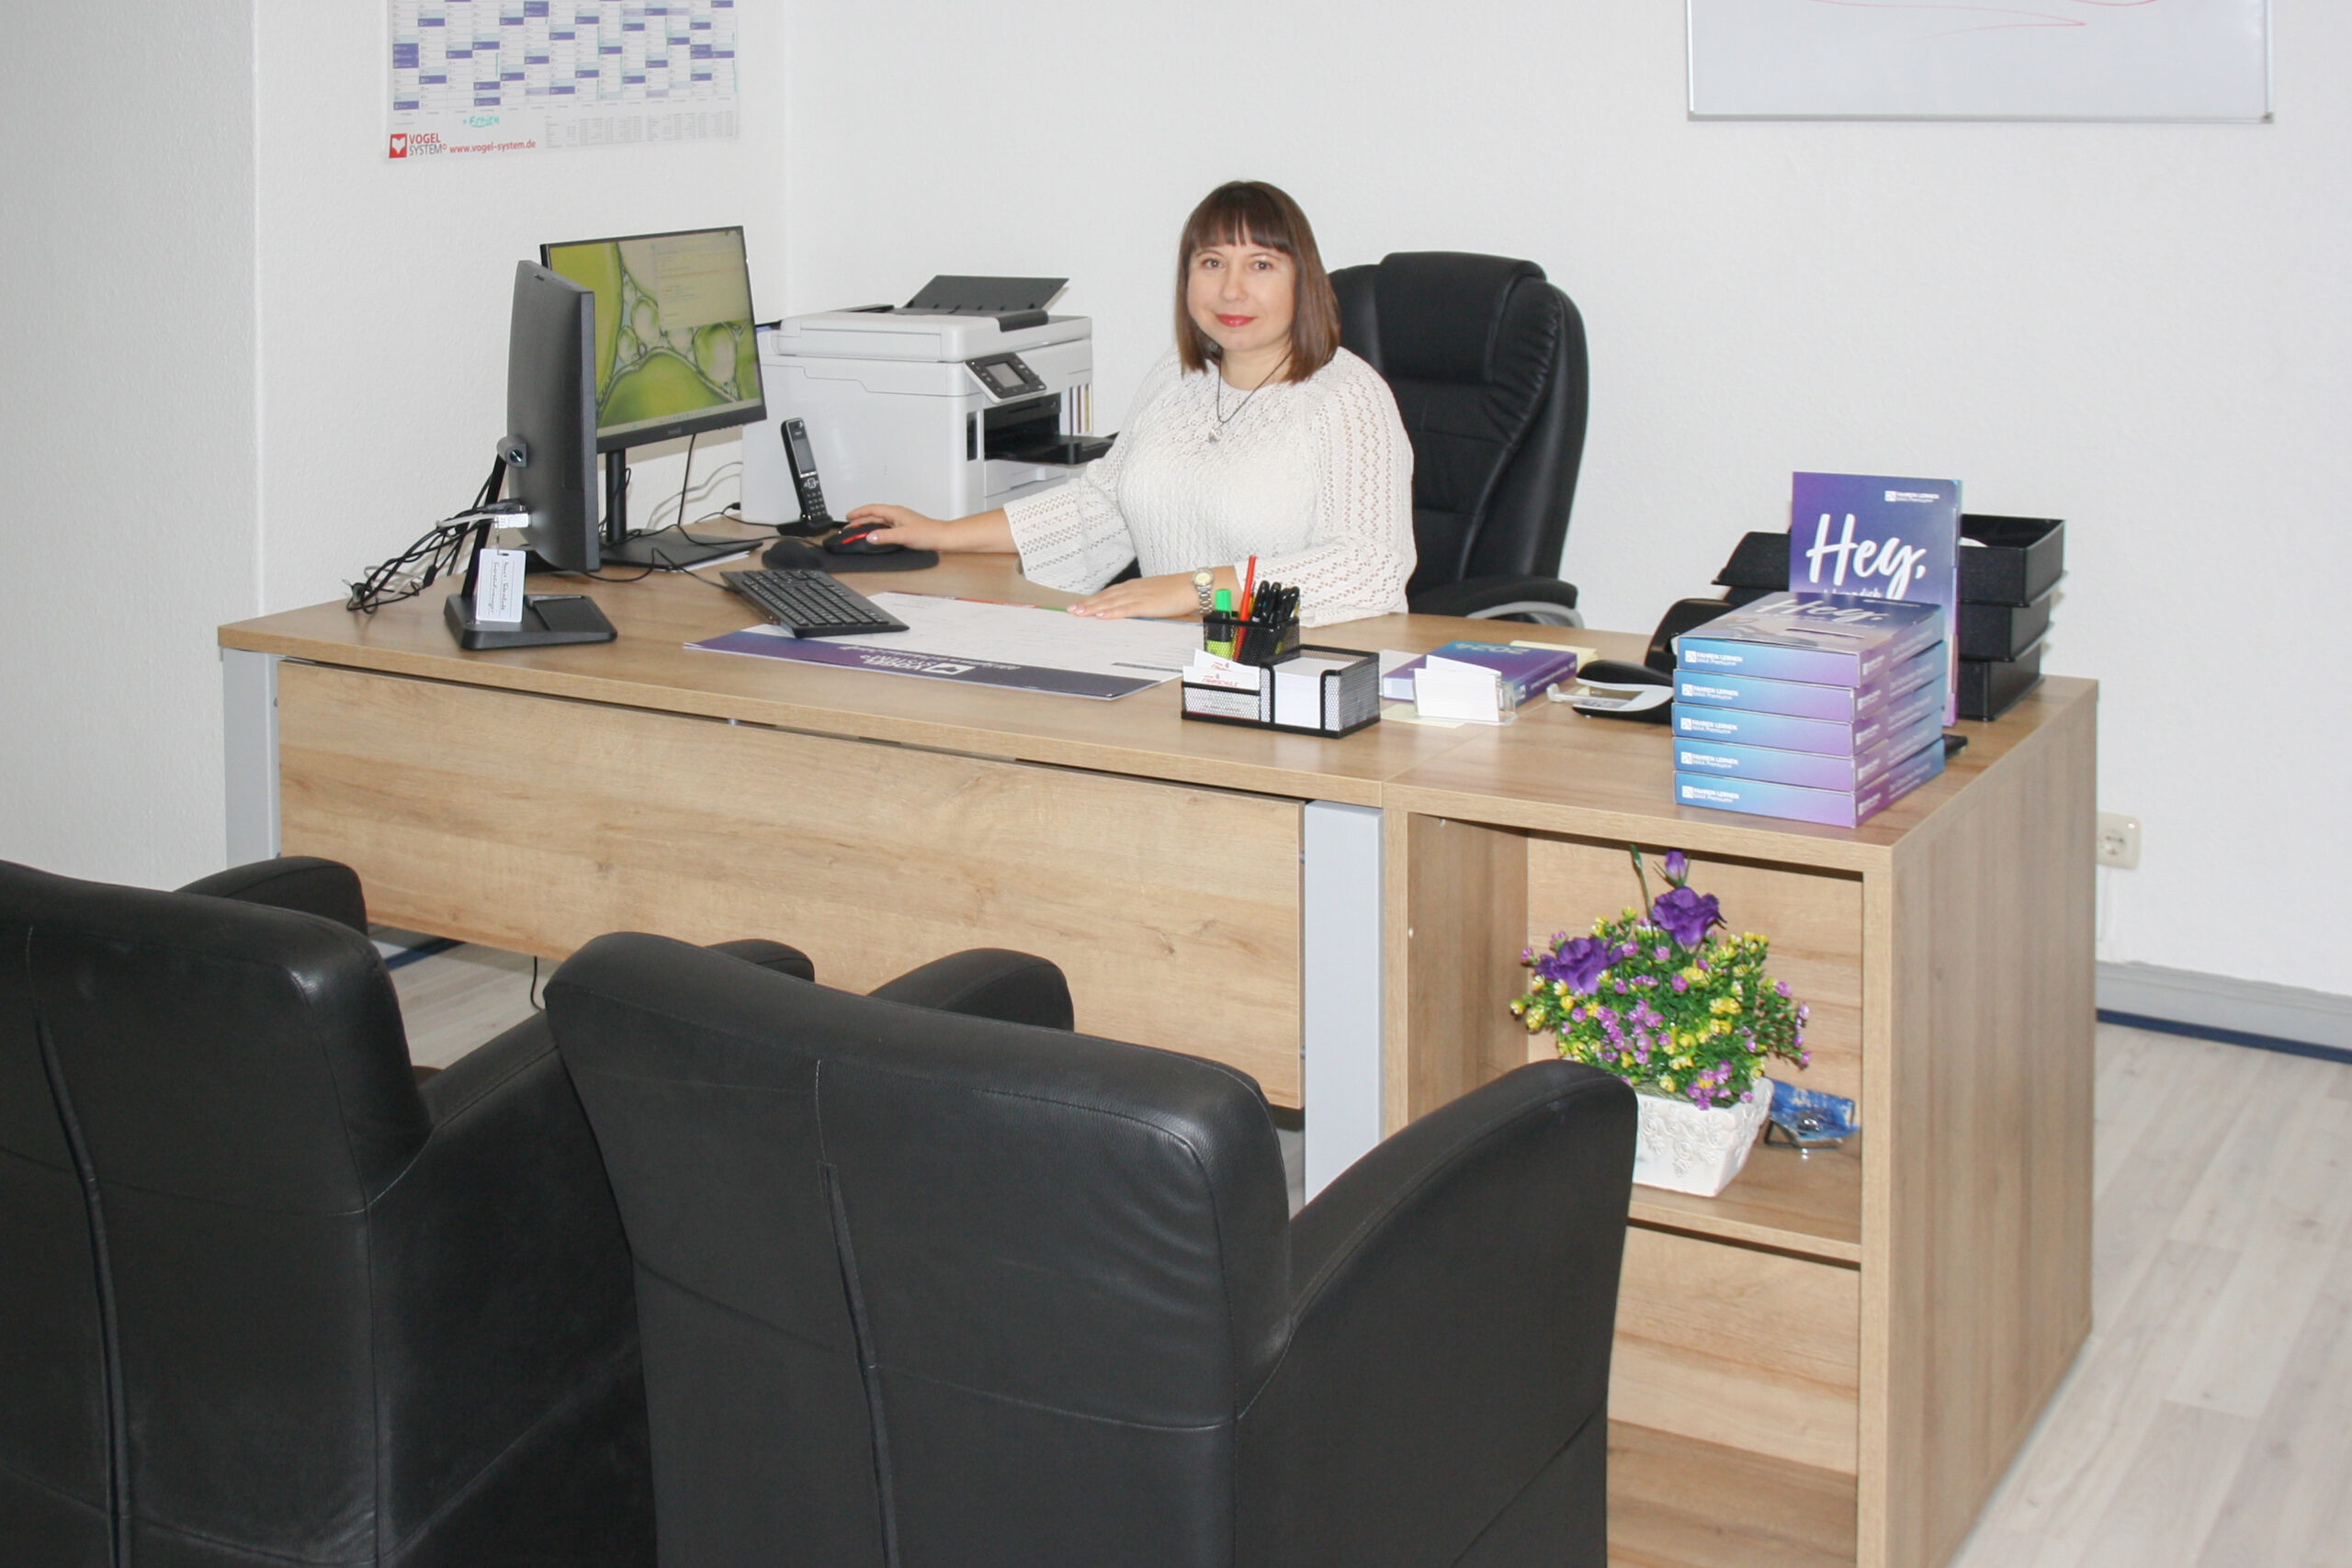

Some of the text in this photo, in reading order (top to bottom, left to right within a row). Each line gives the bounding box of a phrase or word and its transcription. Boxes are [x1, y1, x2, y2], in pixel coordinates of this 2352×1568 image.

[409, 133, 441, 144] VOGEL
[449, 140, 537, 153] www.vogel-system.de
[1805, 513, 1927, 600] Hey,
